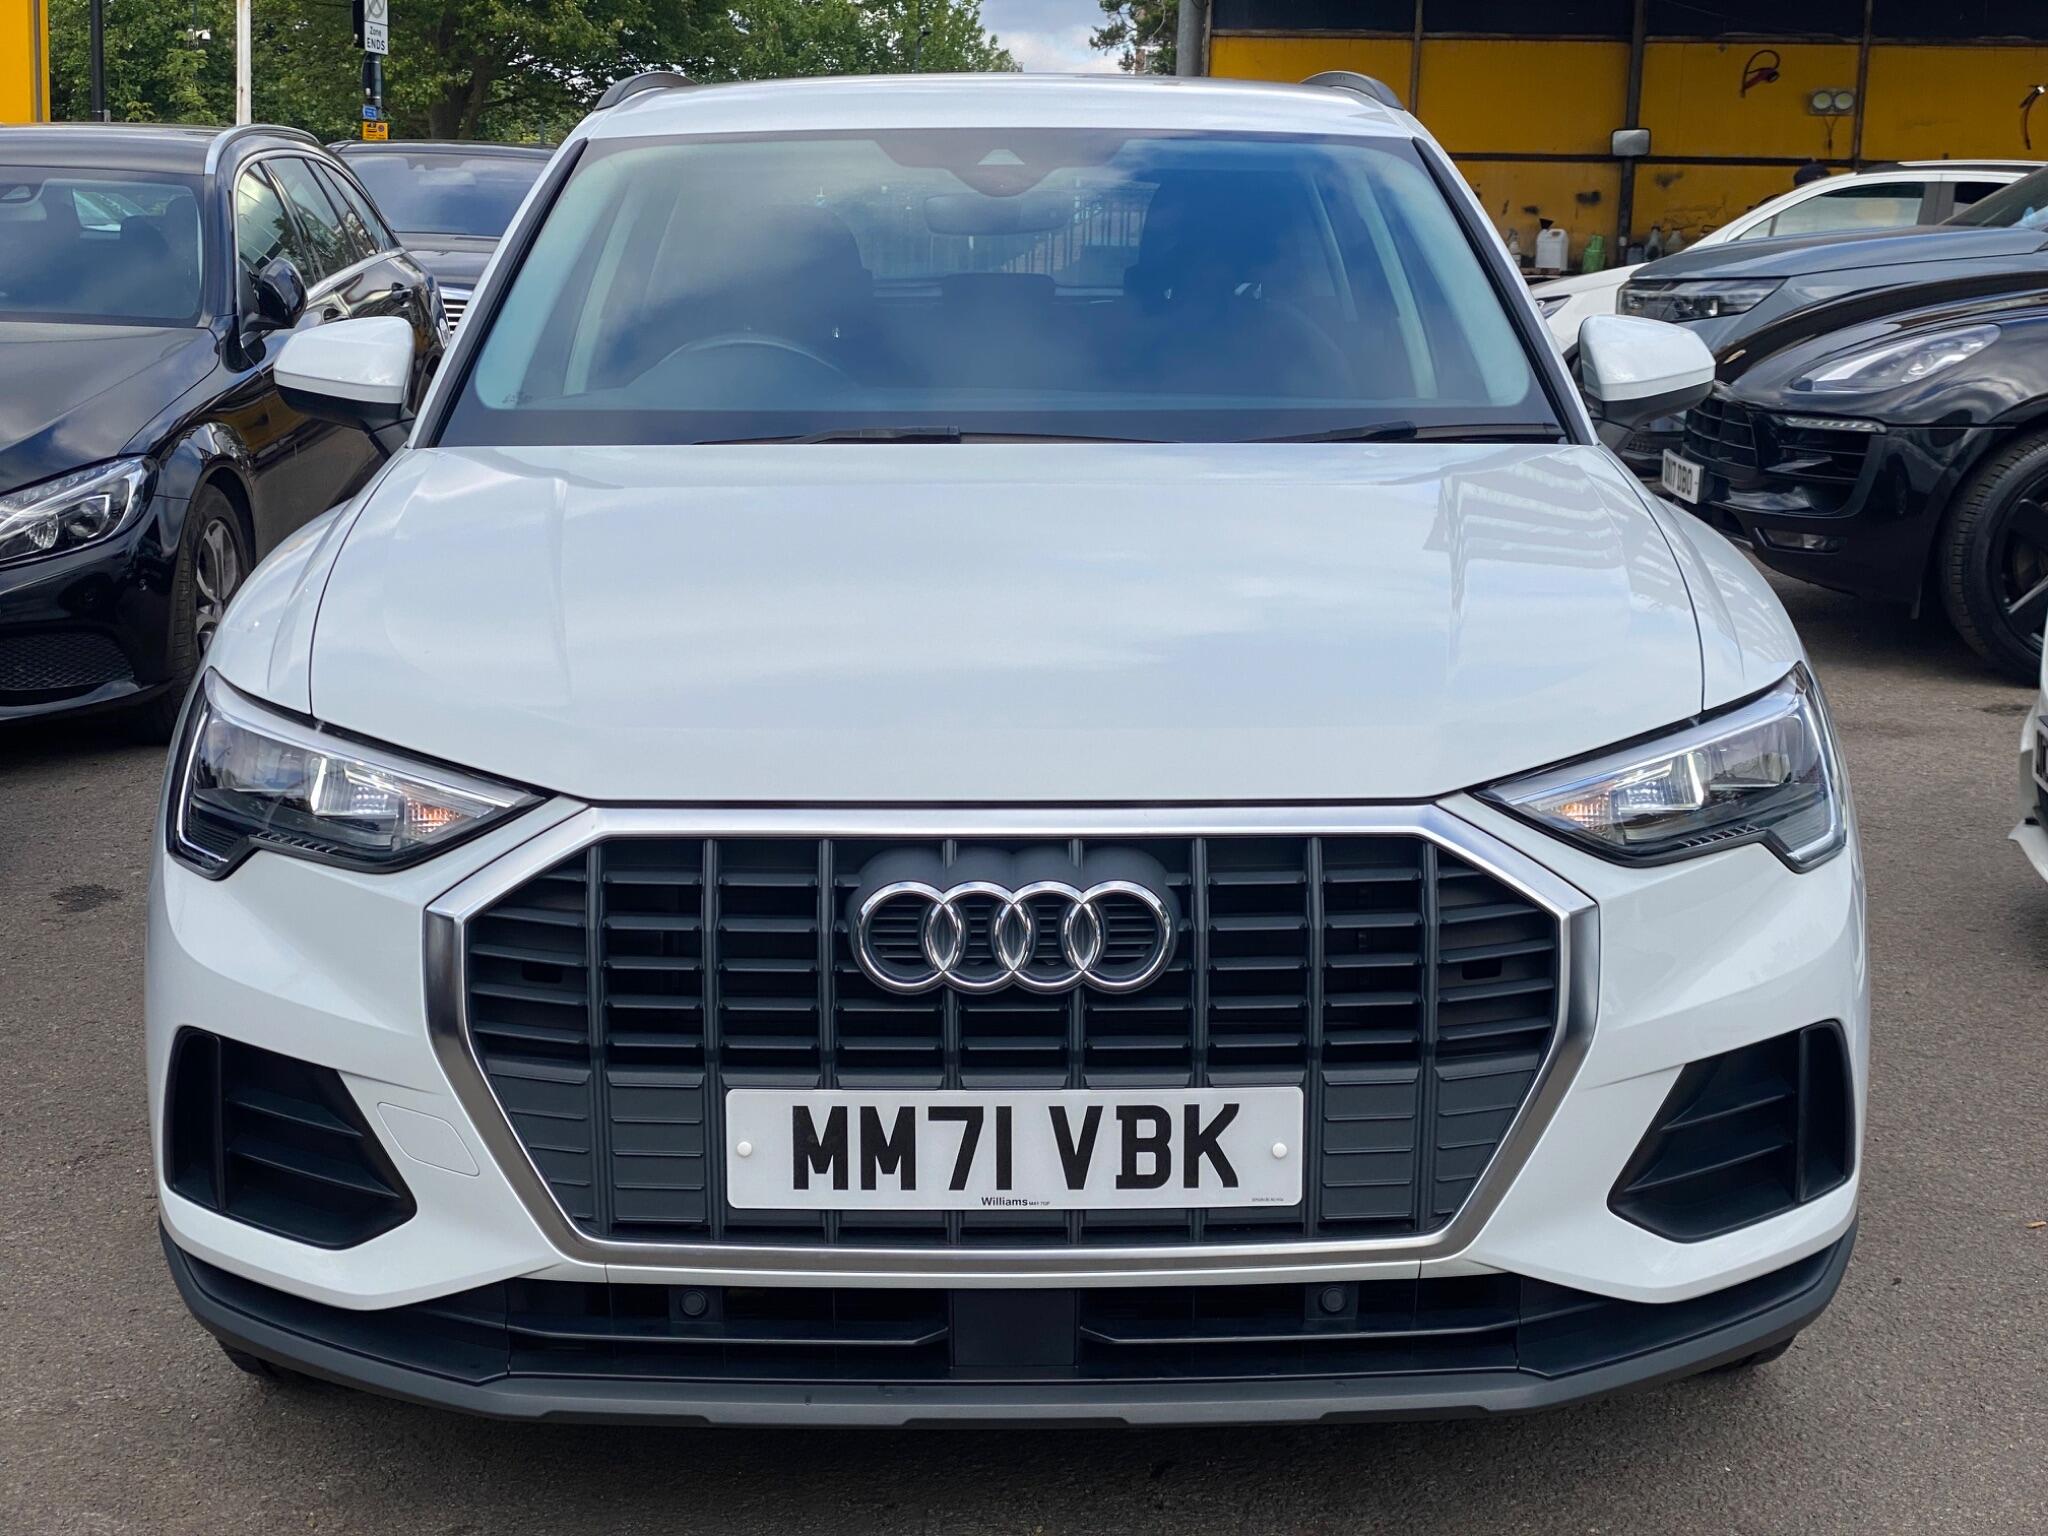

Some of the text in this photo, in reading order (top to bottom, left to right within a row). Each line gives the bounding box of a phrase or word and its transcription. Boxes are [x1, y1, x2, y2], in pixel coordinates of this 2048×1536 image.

[370, 25, 382, 37] Zone
[366, 37, 386, 51] ENDS
[793, 1103, 1240, 1191] MM71 VBK
[981, 1197, 1028, 1207] Williams
